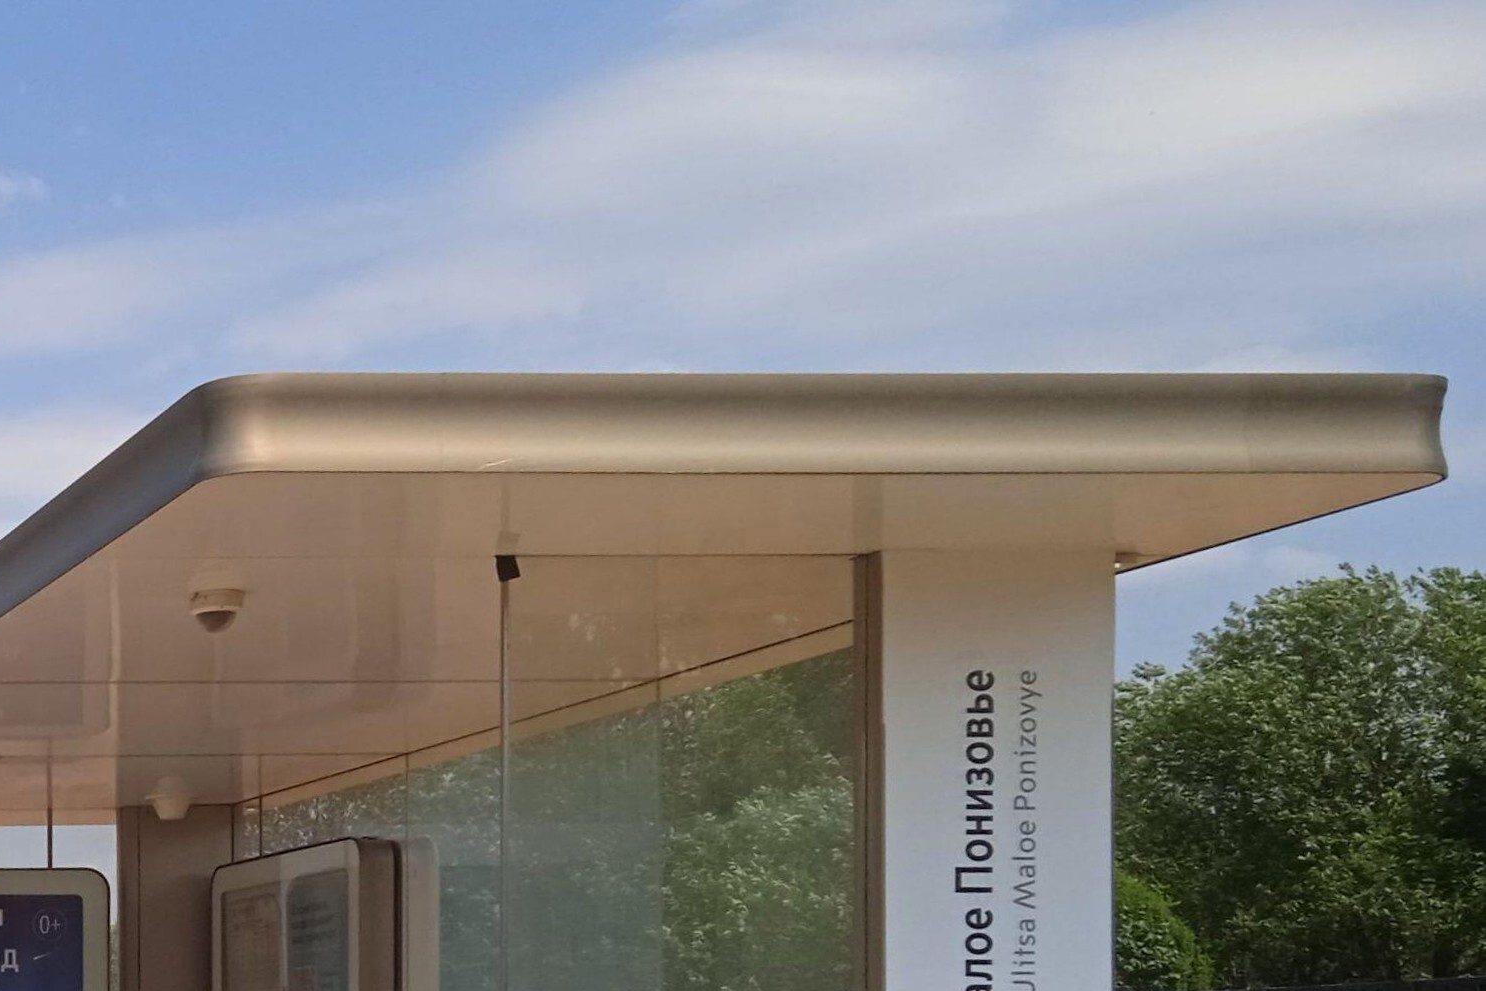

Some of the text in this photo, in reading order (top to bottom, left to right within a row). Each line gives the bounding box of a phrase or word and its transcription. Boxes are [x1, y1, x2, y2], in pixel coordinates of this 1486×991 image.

[954, 669, 995, 894] Понизовье
[1013, 669, 1043, 811] Ponizovye
[1011, 820, 1037, 910] Maloe
[38, 915, 61, 934] 0+
